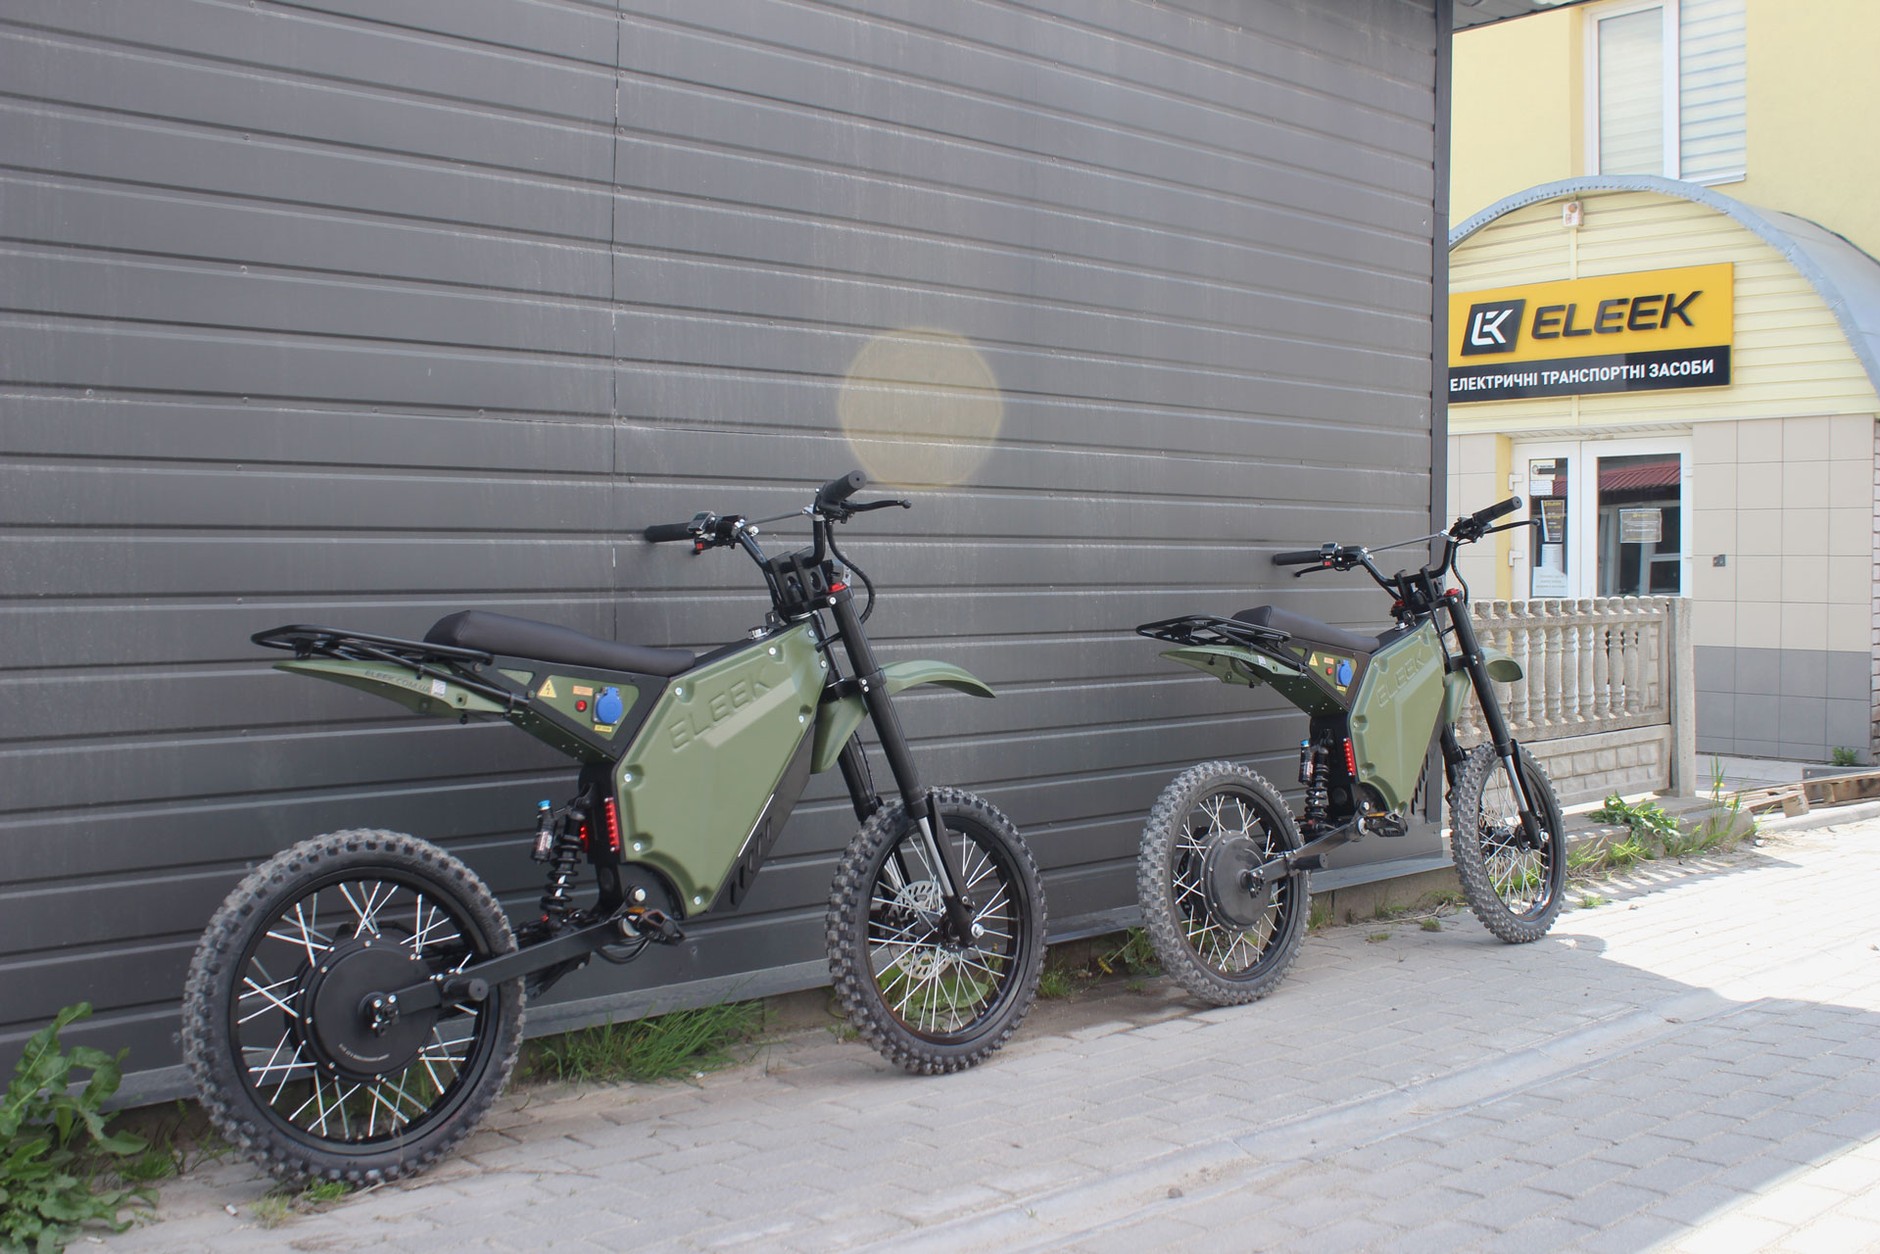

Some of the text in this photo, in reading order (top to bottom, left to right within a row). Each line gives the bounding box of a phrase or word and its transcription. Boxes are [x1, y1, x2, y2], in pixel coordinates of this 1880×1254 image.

[1531, 290, 1703, 340] ELEEK
[1450, 358, 1714, 392] ЕЛЕКТРИЧНІ ТРАНСПОРТНІ ЗАСОБИ
[1376, 647, 1425, 708] ELEEK
[668, 664, 772, 753] ELEEK
